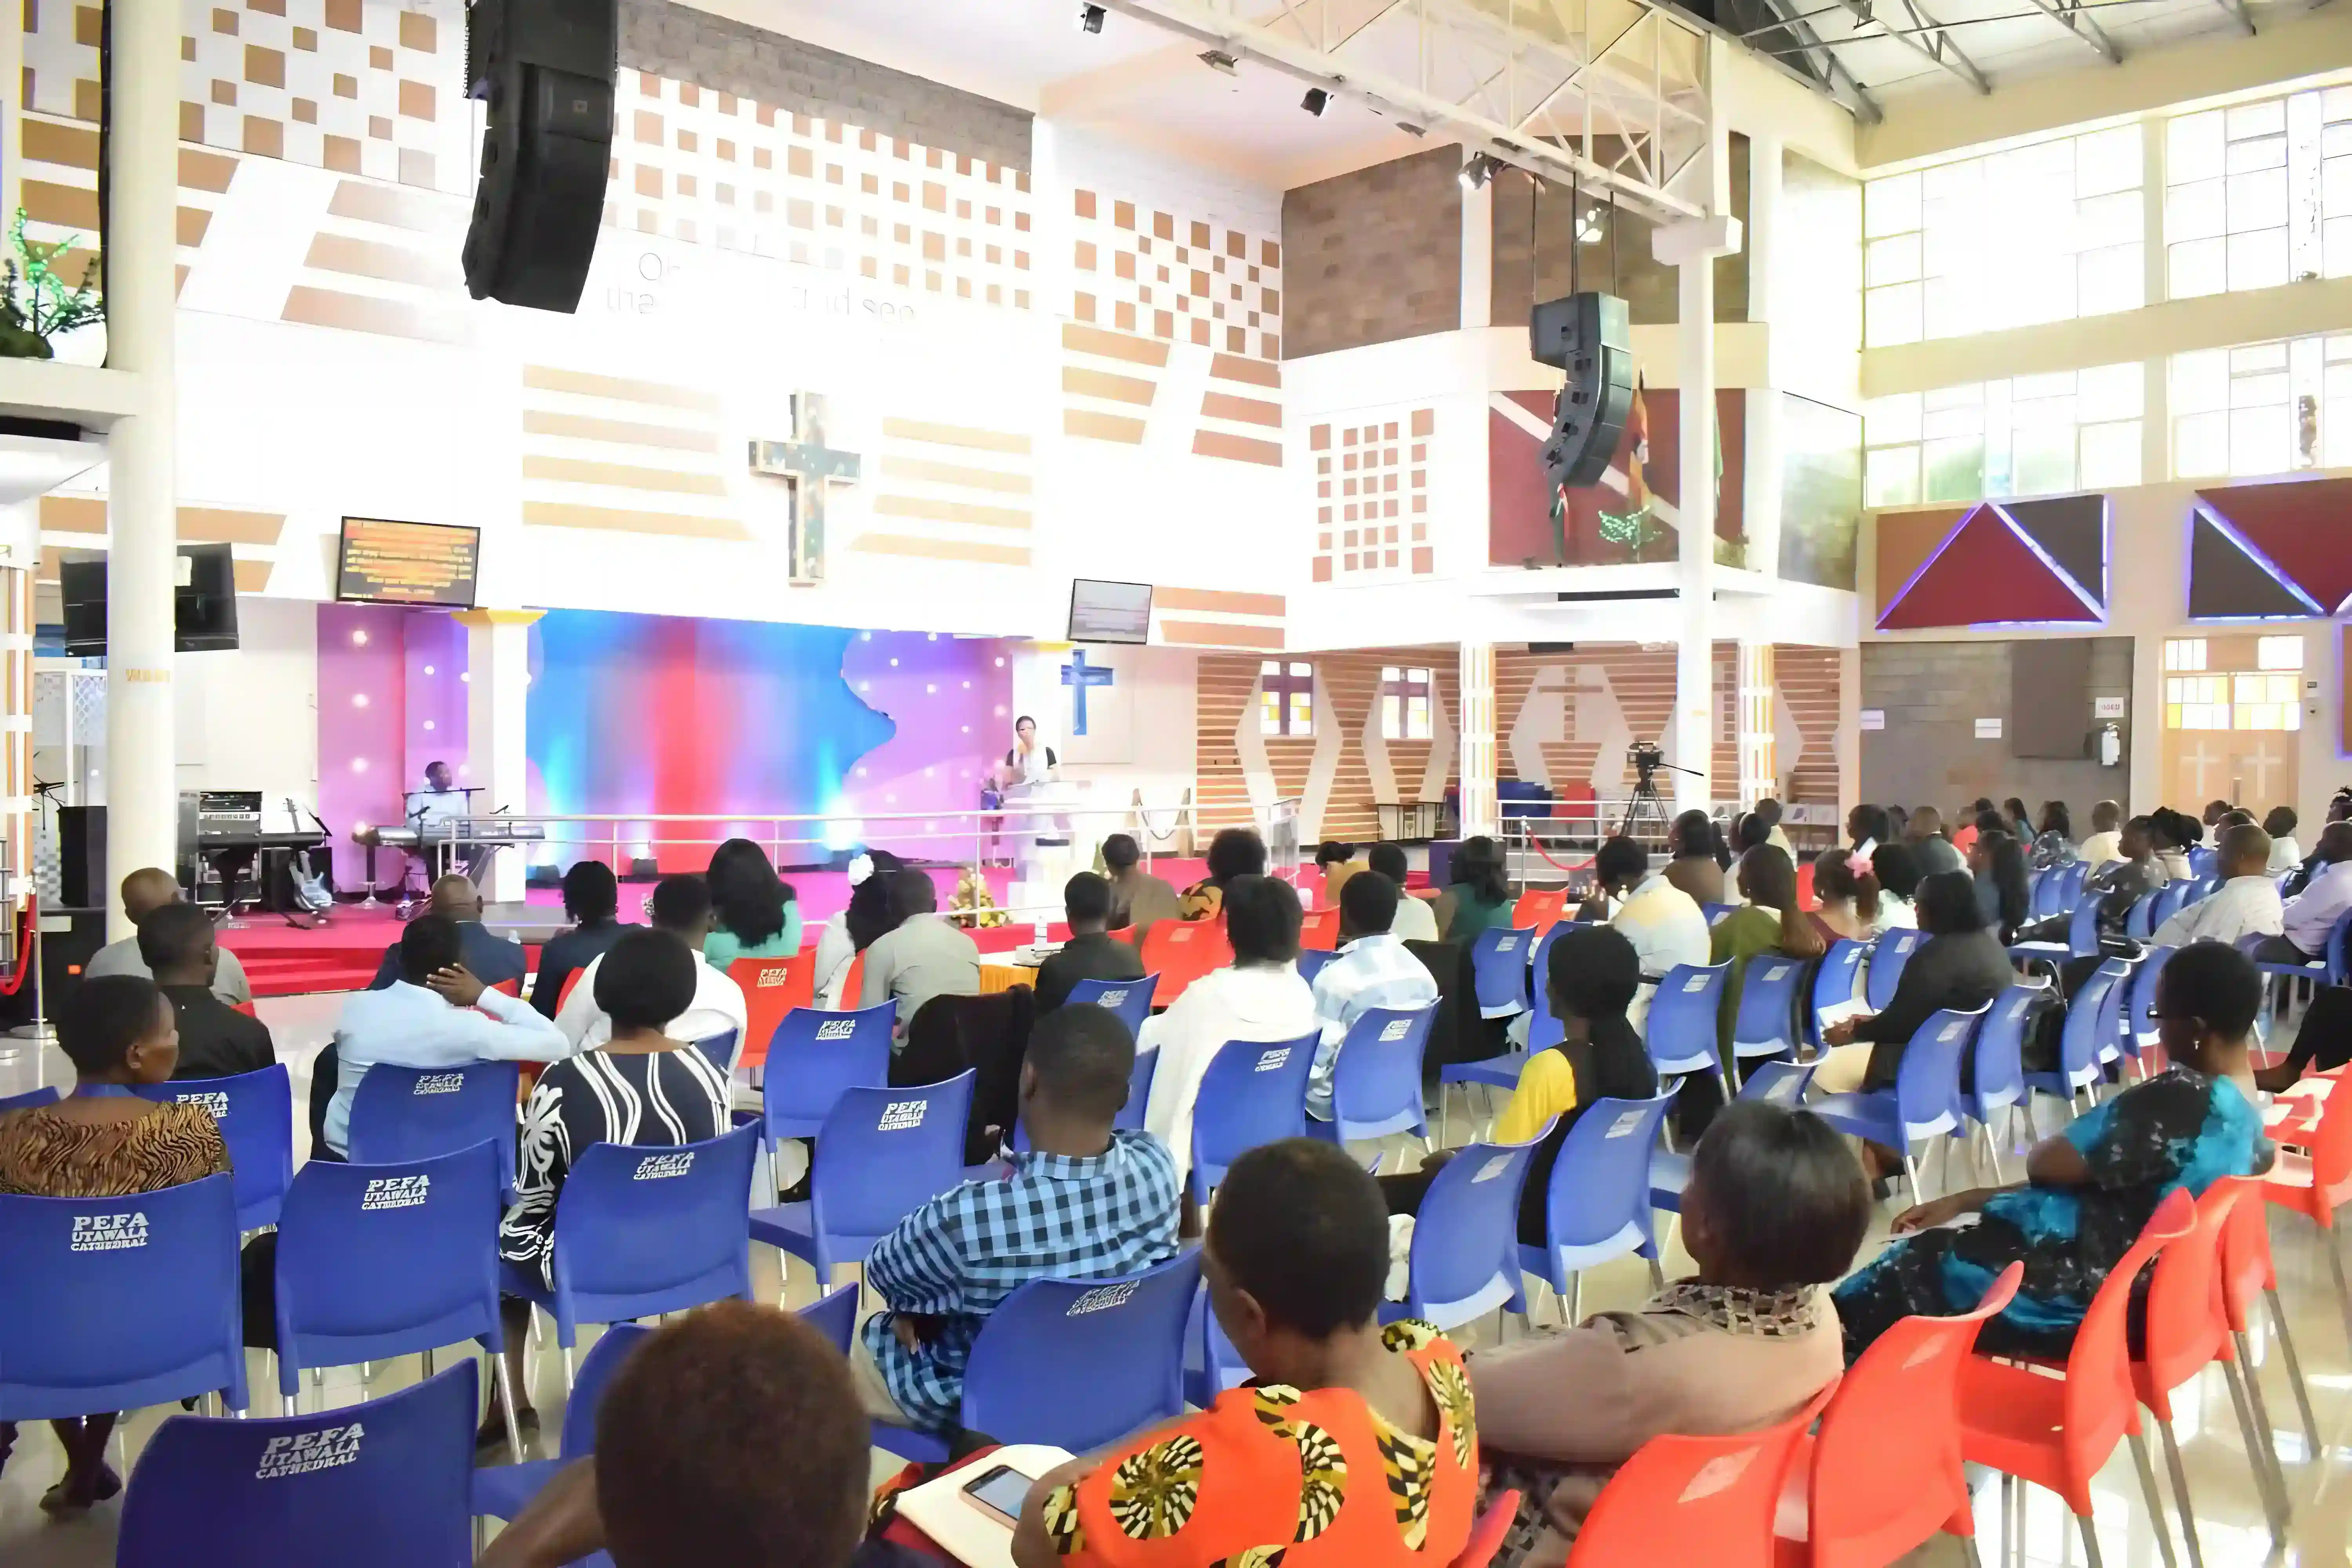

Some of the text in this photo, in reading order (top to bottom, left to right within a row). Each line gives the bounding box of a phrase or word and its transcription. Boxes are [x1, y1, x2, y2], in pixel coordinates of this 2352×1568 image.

[176, 1092, 229, 1104] PEFA
[366, 1175, 431, 1192] PEFA
[364, 1187, 427, 1201] UTAWALA
[73, 1212, 149, 1231] PEFA
[71, 1227, 149, 1242] UTAWALA
[263, 1423, 365, 1454] PEFA
[260, 1439, 360, 1467] UTAWALA
[256, 1452, 357, 1479] CATHEDRAL
